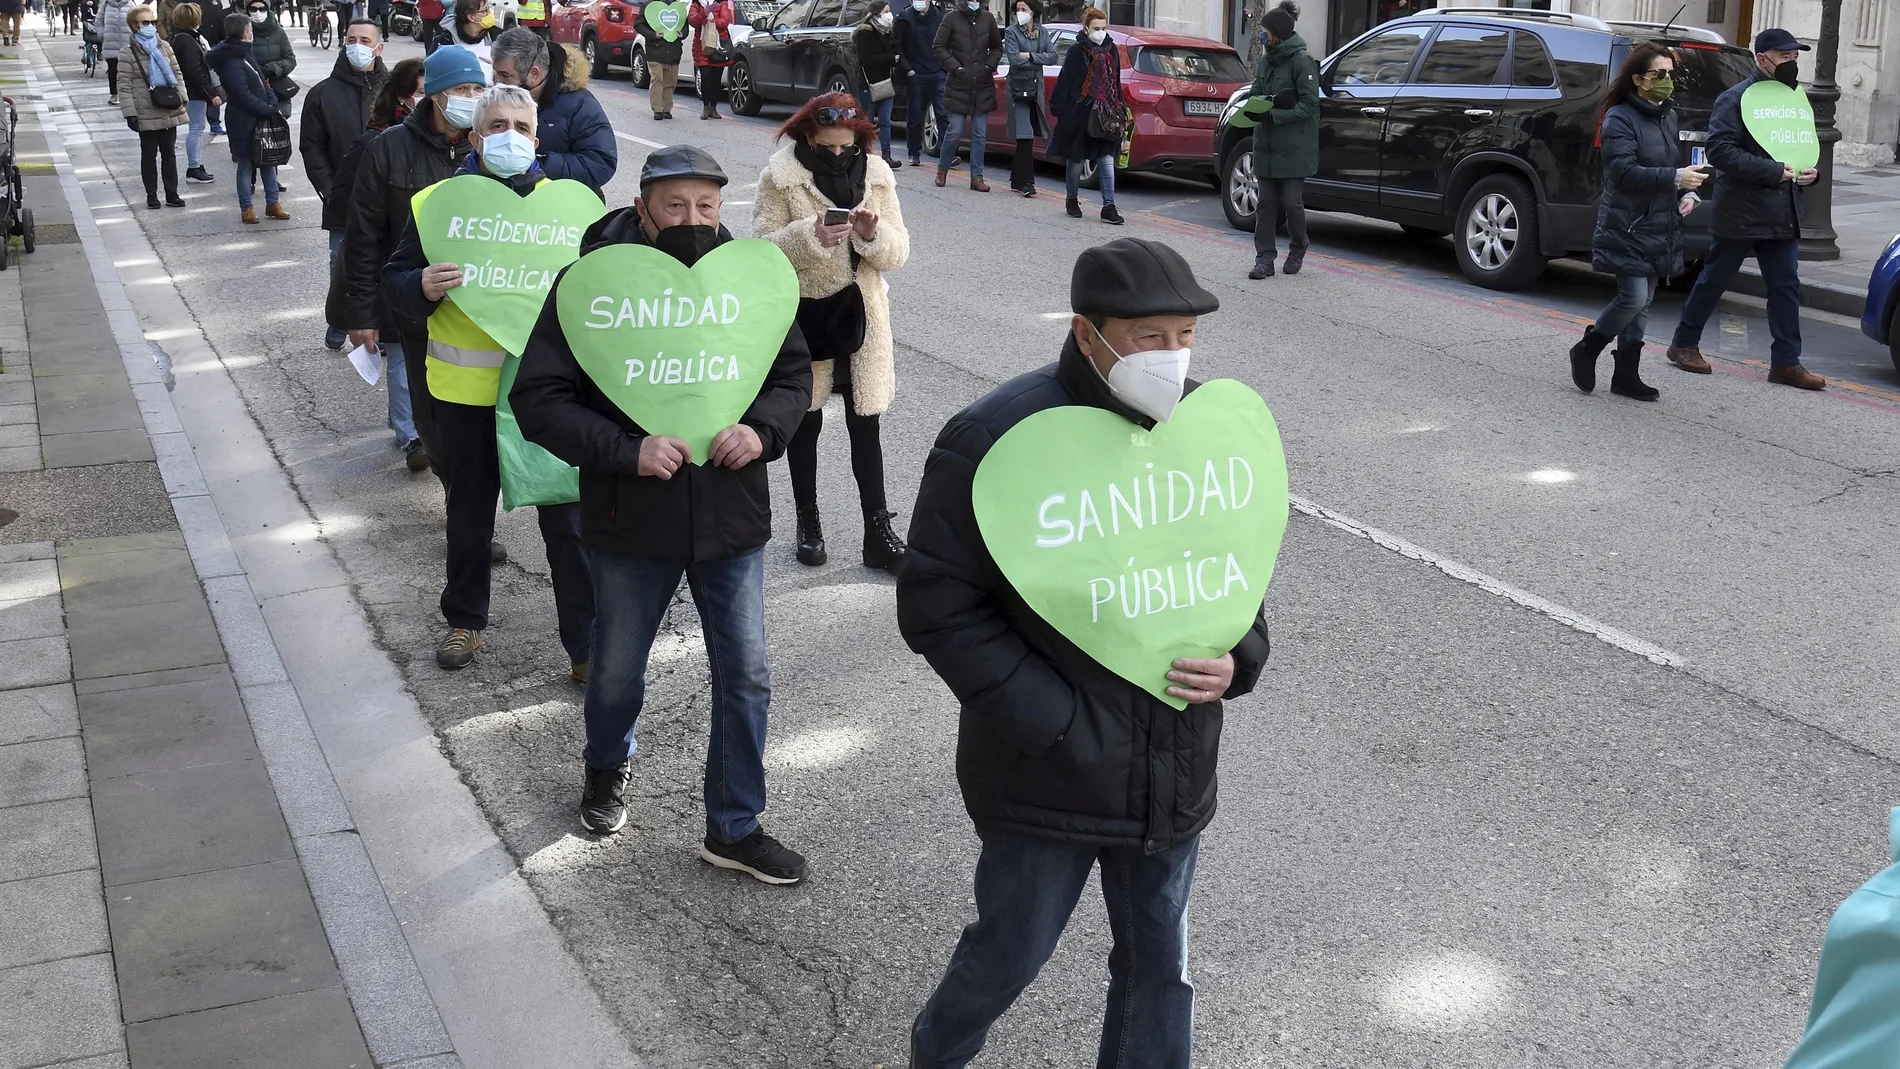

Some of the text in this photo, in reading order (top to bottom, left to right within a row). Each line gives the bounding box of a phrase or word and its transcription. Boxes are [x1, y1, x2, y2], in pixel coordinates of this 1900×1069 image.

[1190, 102, 1227, 114] 6934 HT
[1753, 105, 1796, 119] SERVICIOS
[1770, 127, 1814, 144] PÚBLICOS
[447, 213, 580, 247] RESIDENCIAS
[584, 288, 740, 329] SANIDAD
[625, 349, 740, 386] PÚBLICA
[1035, 456, 1254, 547] SANIDAD
[1088, 550, 1249, 623] PÚBLICA
